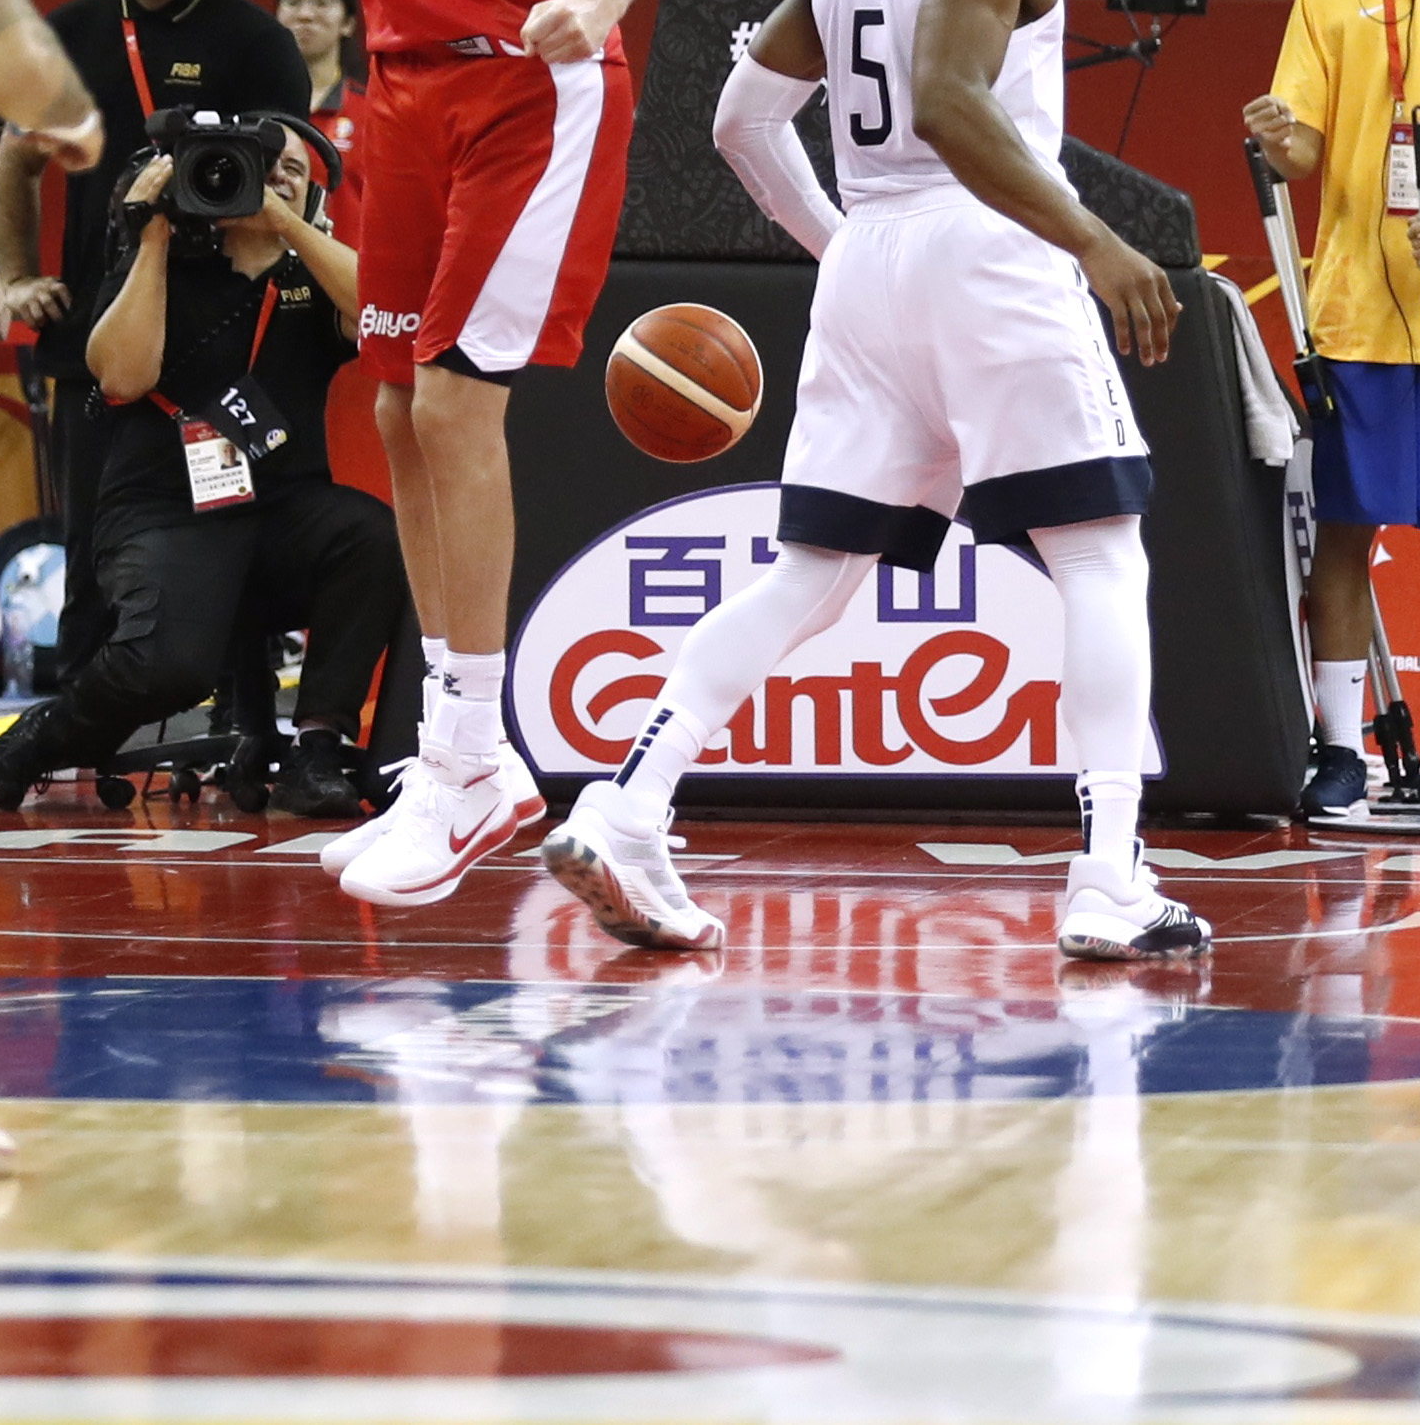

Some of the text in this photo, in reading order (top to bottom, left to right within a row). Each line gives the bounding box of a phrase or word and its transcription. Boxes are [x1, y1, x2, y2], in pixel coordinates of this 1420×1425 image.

[849, 8, 893, 147] 5
[220, 387, 257, 426] 127
[625, 535, 977, 626] 百山
